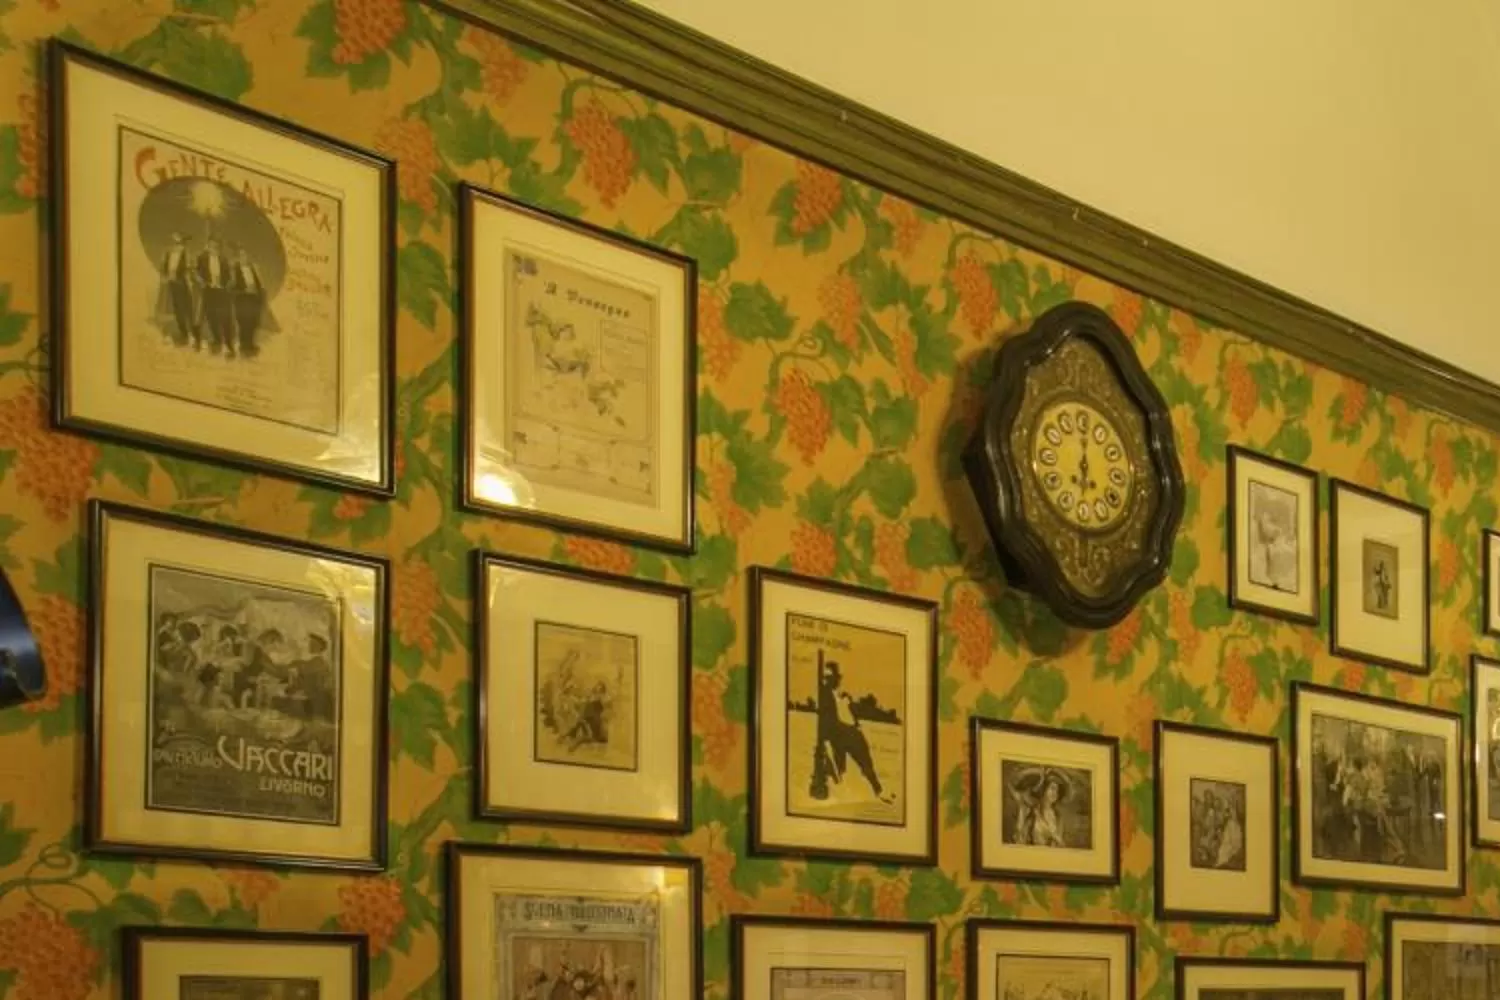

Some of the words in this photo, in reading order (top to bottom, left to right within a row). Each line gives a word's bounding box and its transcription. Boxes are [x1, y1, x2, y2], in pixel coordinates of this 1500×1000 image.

[134, 146, 226, 190] GENTE
[241, 180, 332, 234] ALLEGRA
[217, 735, 333, 780] VACCARI
[259, 777, 326, 798] LIVORNO
